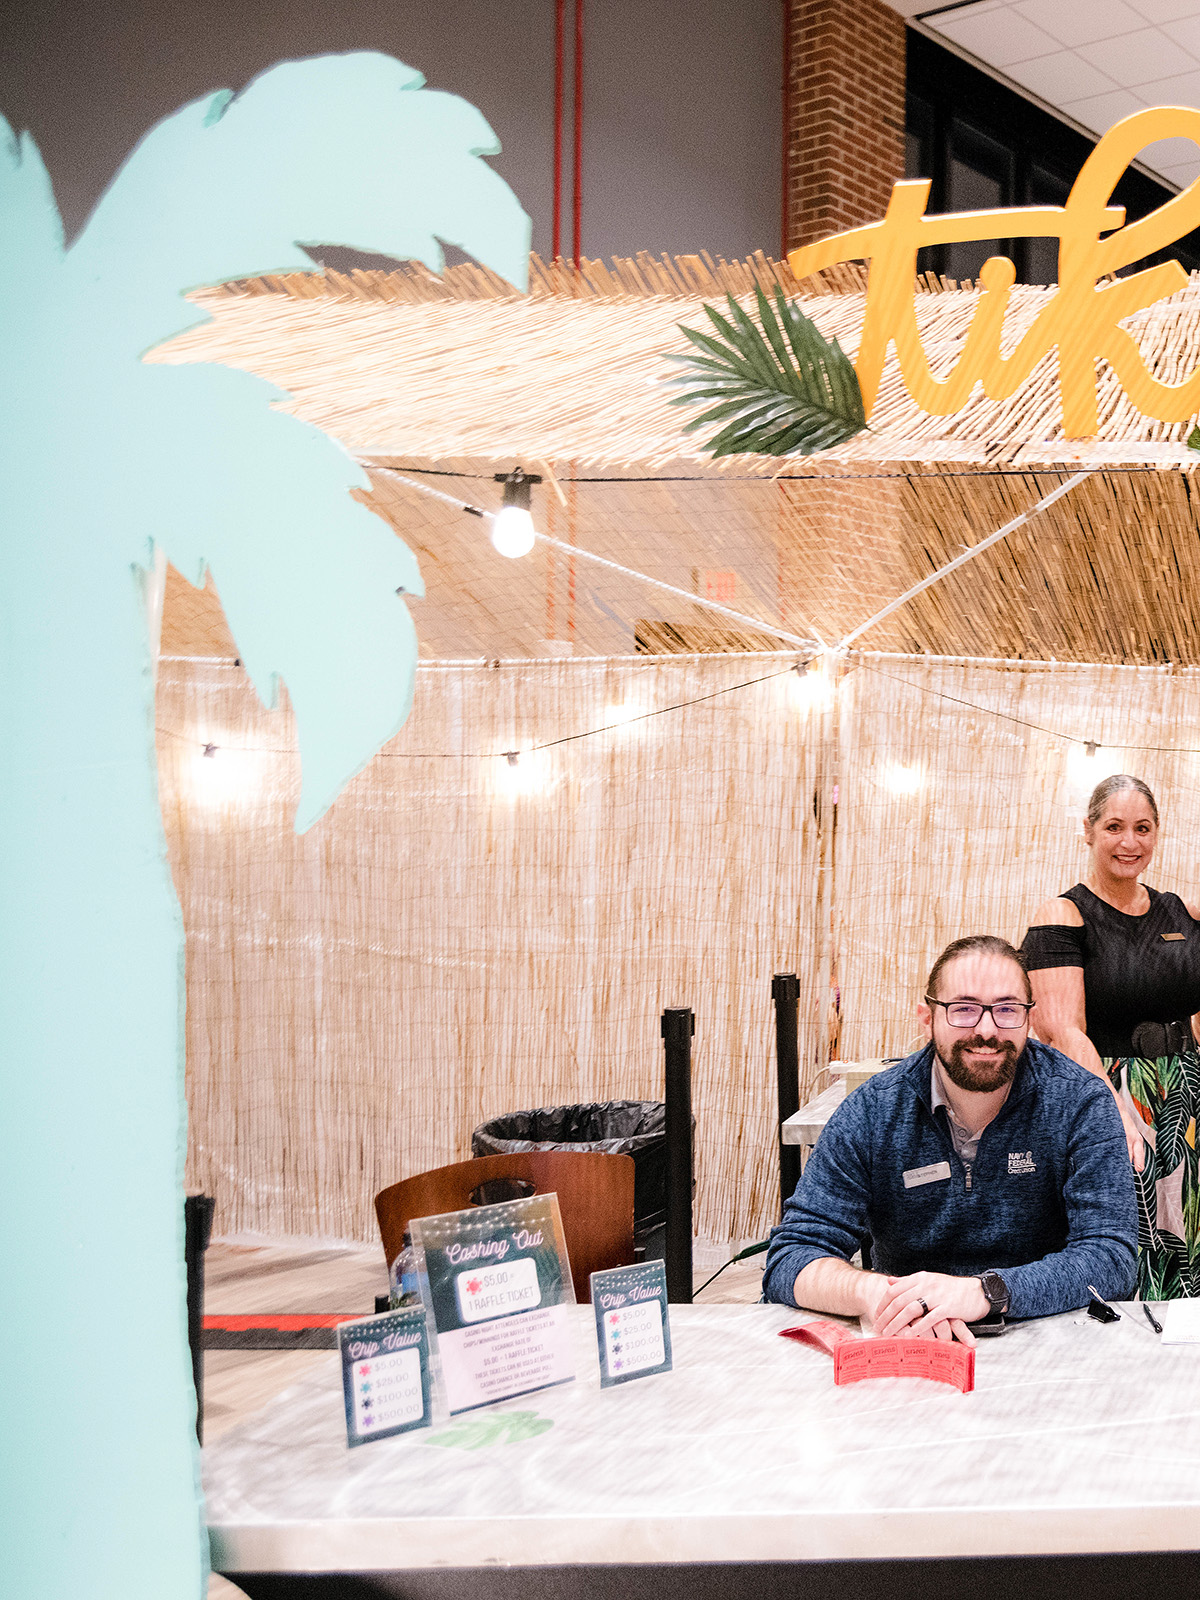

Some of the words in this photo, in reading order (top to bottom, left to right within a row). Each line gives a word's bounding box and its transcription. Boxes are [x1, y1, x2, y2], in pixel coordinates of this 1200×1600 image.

[446, 1239, 510, 1264] Cashing
[512, 1229, 544, 1249] Out
[484, 1272, 508, 1287] $5.00
[473, 1292, 505, 1309] RAFFLE
[507, 1287, 534, 1302] TICKET
[600, 1293, 626, 1308] Chip
[629, 1286, 662, 1301] Value
[623, 1309, 646, 1320] $5.00
[624, 1322, 652, 1335] $25.00
[349, 1341, 379, 1358] Chip
[383, 1331, 422, 1350] Value
[625, 1335, 660, 1350] $100.00
[375, 1359, 403, 1371] $5.00
[627, 1351, 661, 1365] $500.00
[376, 1373, 409, 1388] $25.00
[377, 1388, 418, 1405] $100.00
[378, 1404, 420, 1422] $500.00
